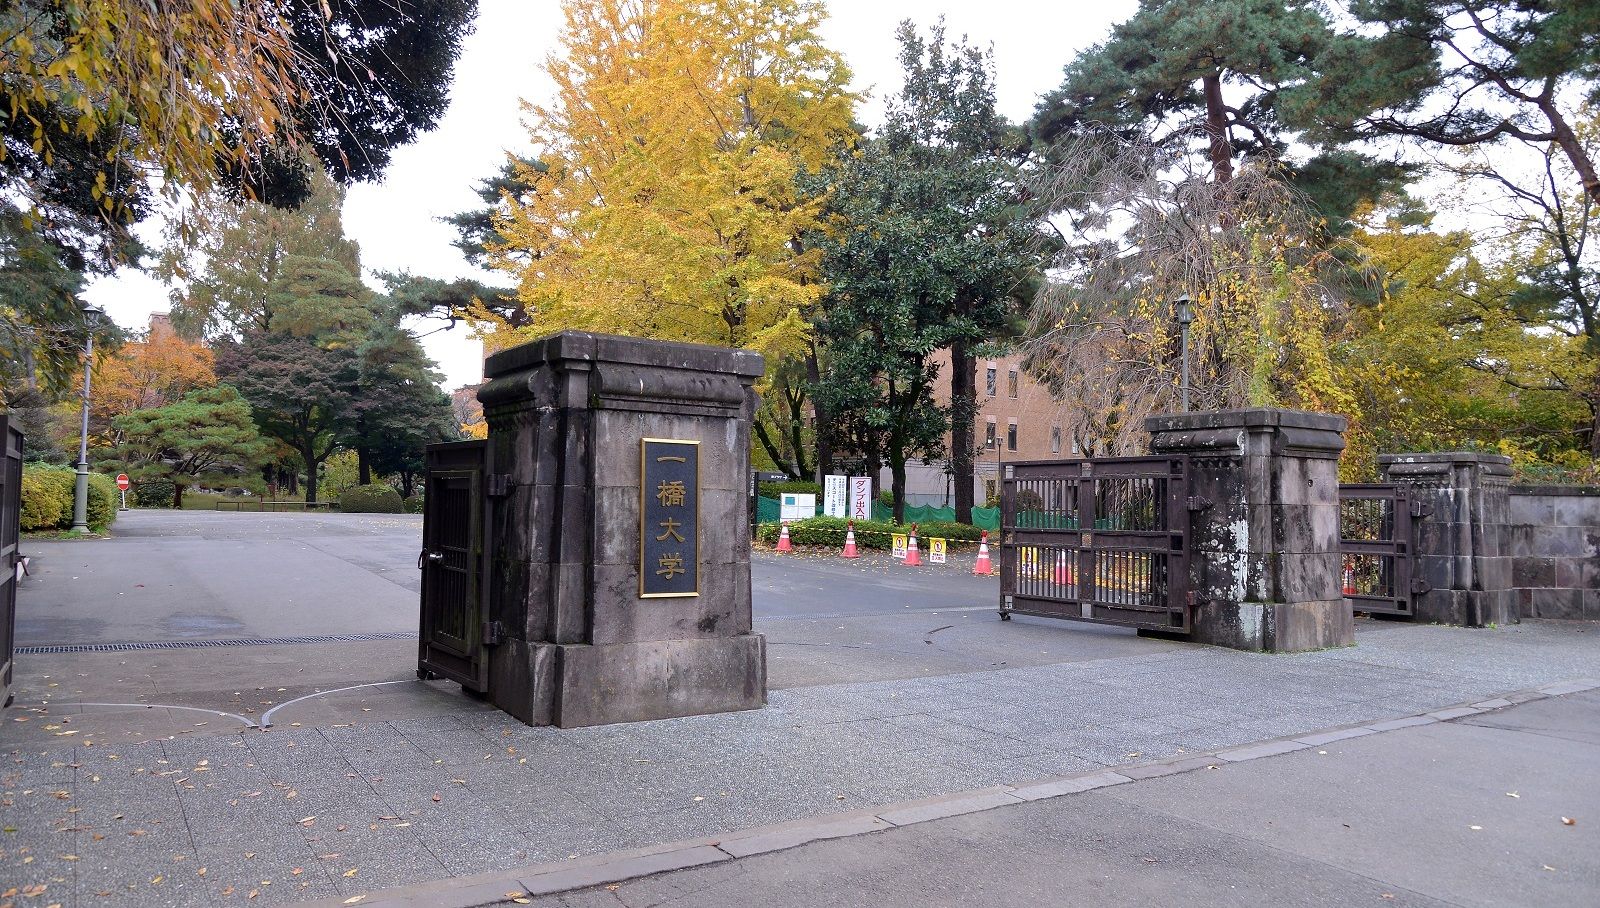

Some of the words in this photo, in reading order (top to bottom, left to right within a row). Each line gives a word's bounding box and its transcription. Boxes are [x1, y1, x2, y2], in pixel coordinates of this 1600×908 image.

[656, 456, 686, 580] 一橋大学
[855, 480, 866, 520] ダンプ出入口
